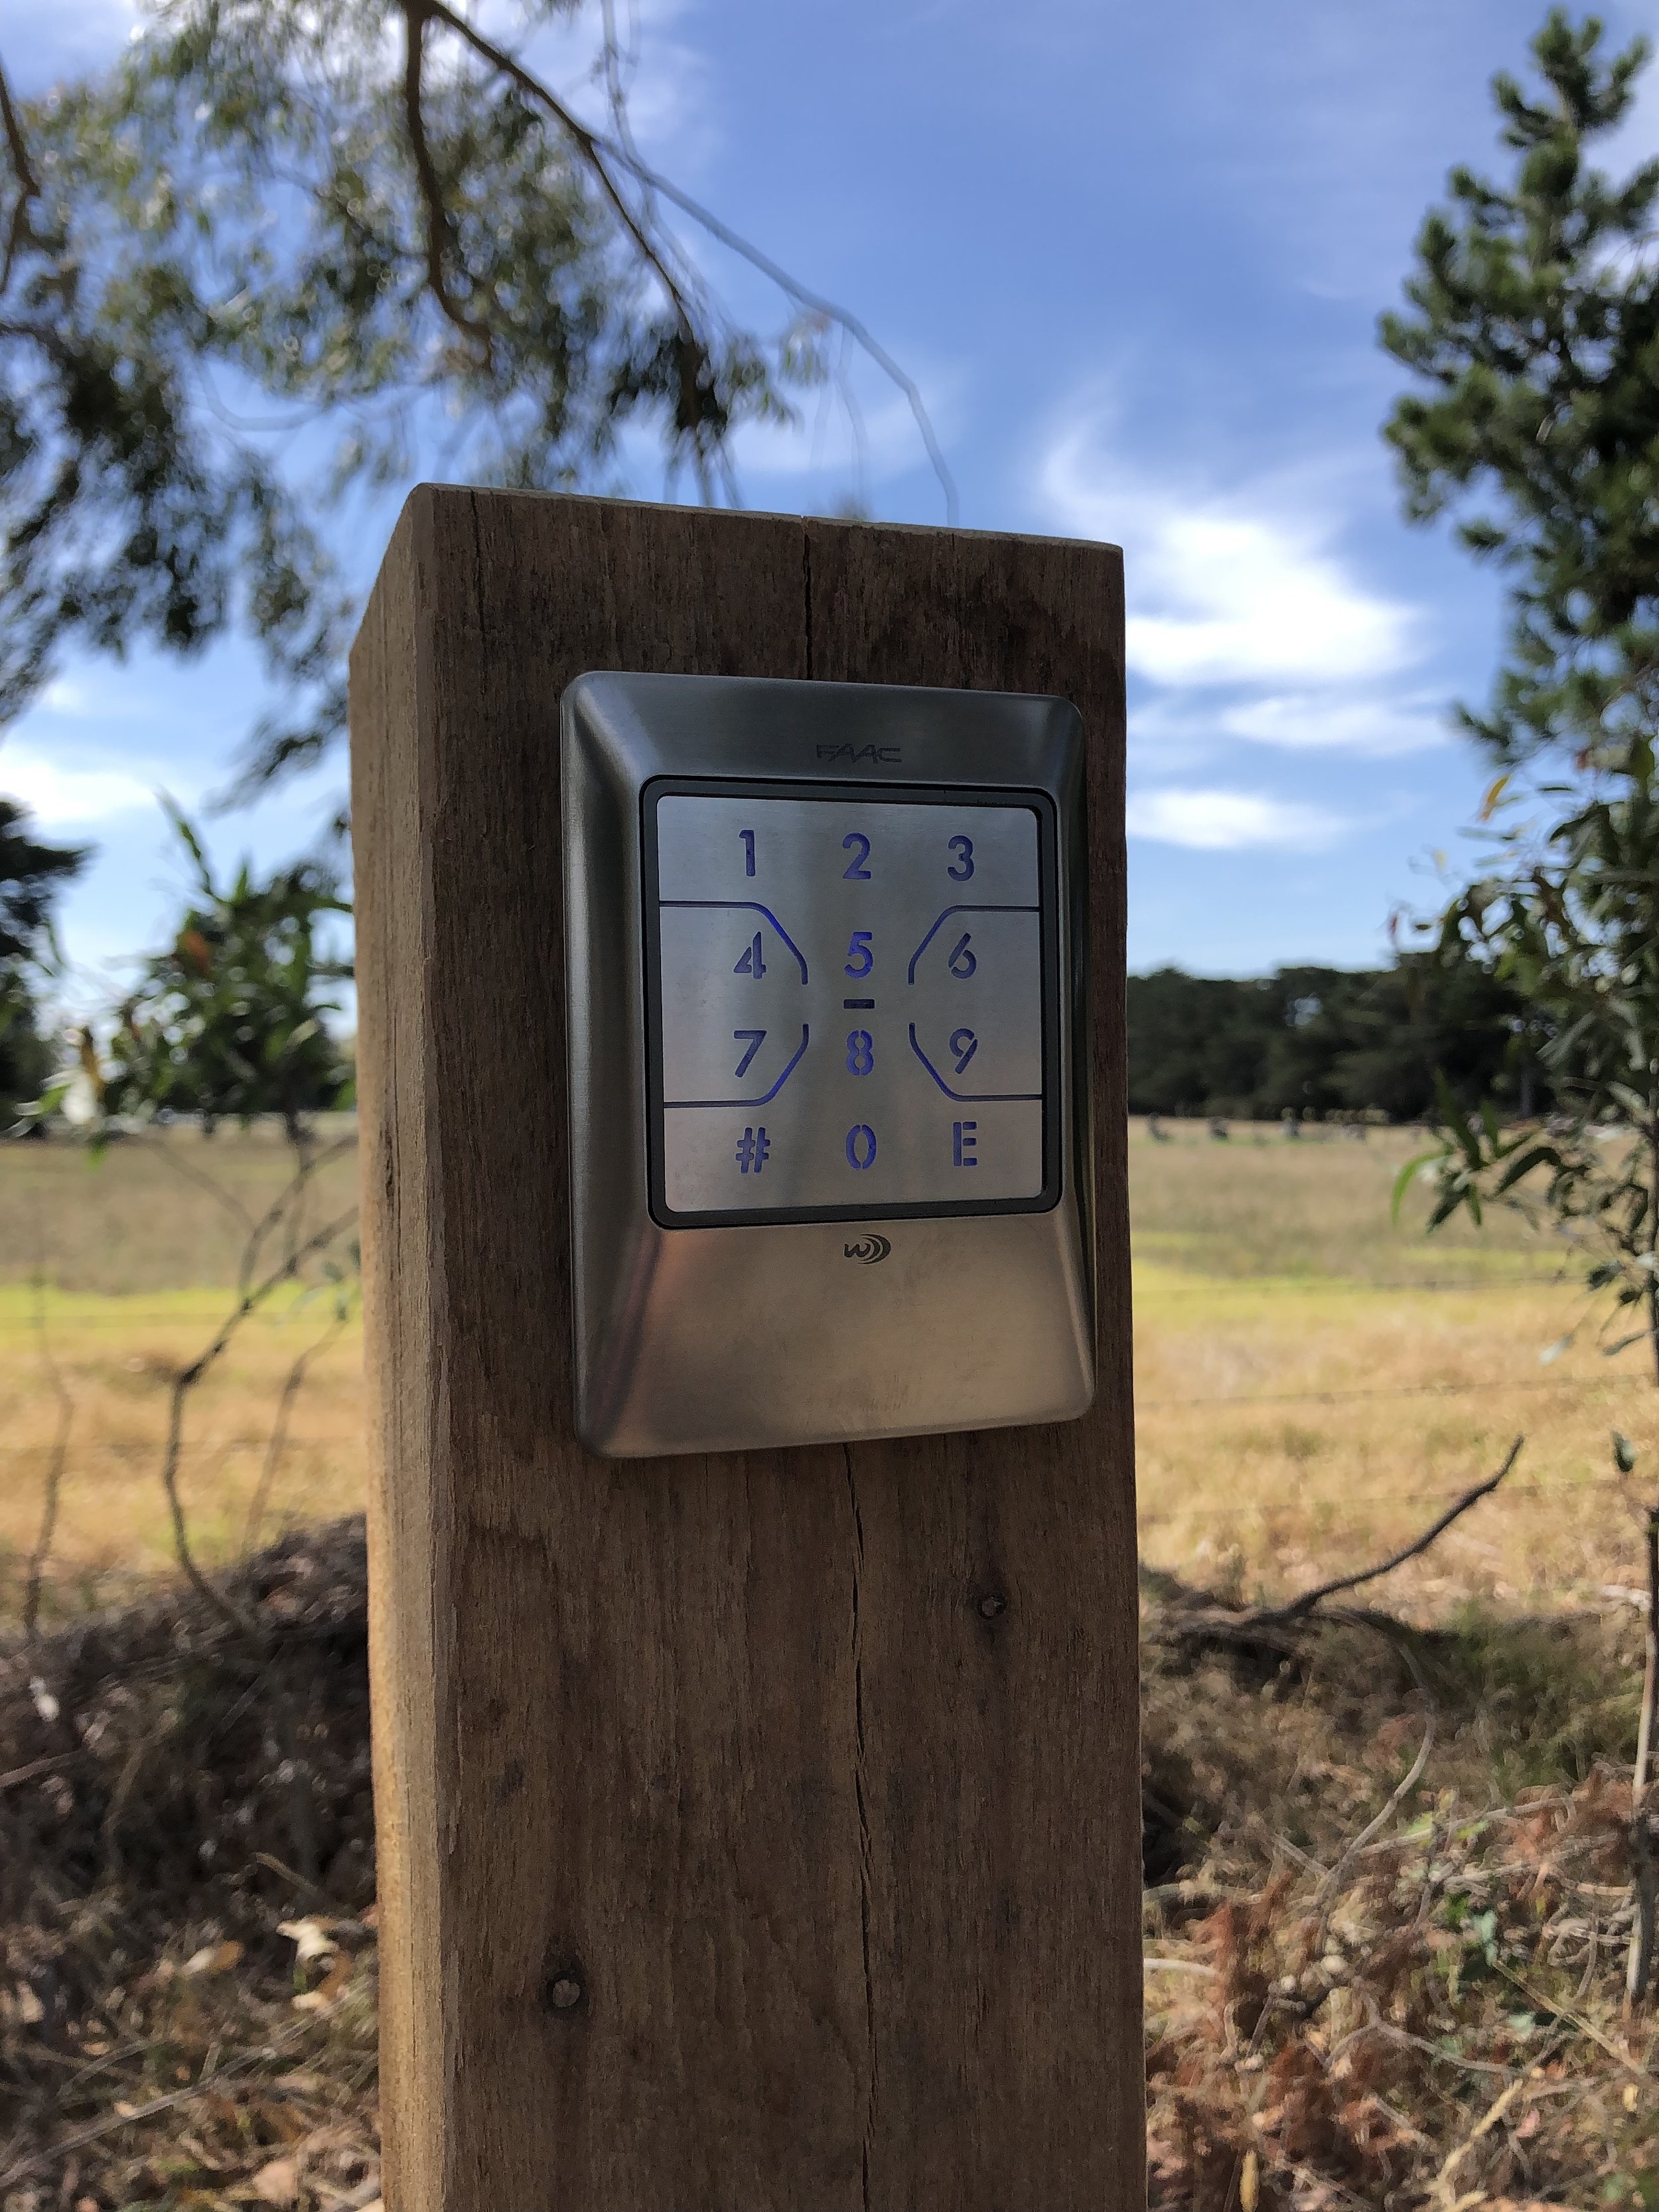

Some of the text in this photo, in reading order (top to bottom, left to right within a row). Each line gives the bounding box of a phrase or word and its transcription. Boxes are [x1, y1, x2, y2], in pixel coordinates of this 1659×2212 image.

[816, 743, 902, 764] FAAC
[738, 829, 975, 881] 1 2 3
[733, 931, 977, 980] 4 5 6
[733, 1028, 978, 1078] 7 8 9
[735, 1121, 977, 1174] # 0 E
